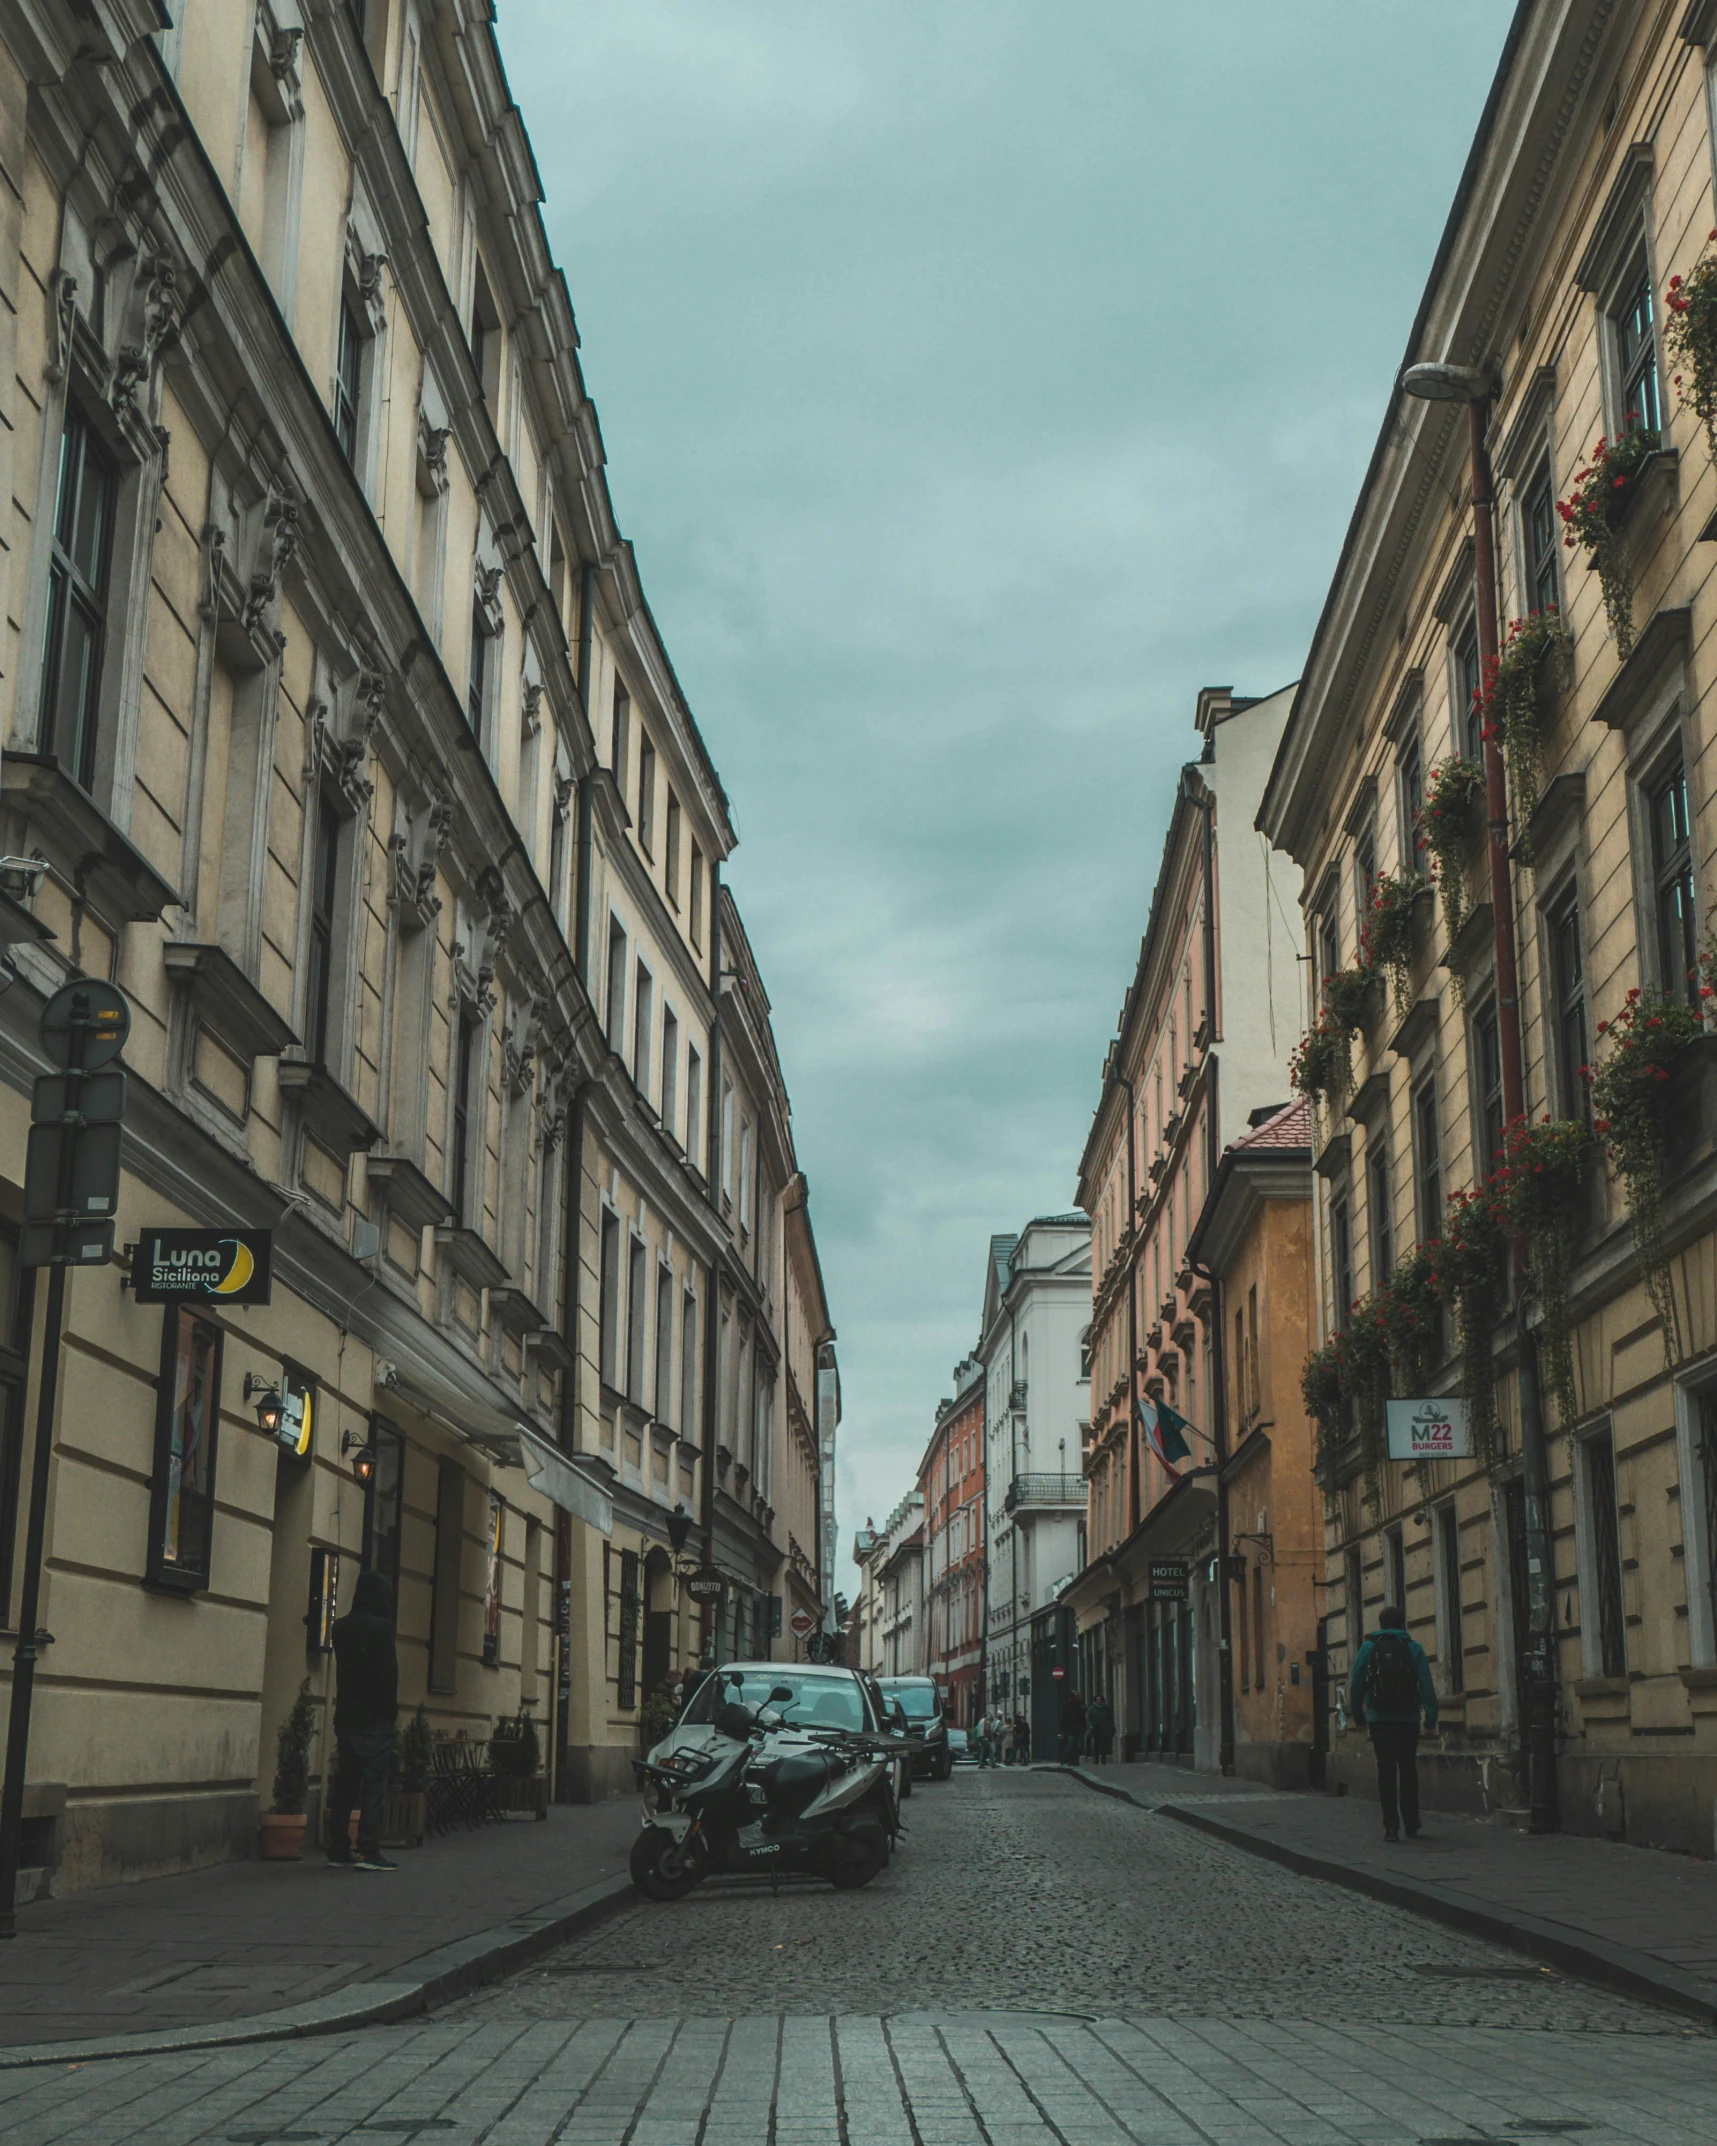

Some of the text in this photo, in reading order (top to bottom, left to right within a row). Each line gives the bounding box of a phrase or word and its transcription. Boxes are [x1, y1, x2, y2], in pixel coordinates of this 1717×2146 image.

[153, 1239, 221, 1266] Luna
[152, 1267, 220, 1282] Siciliana
[151, 1282, 197, 1290] RISTORANTE
[1411, 1424, 1452, 1441] M22
[1412, 1442, 1453, 1450] BURGERS
[1152, 1567, 1185, 1576] HOTEL
[690, 1581, 721, 1592] DONIZETTI
[1153, 1588, 1185, 1597] UNICUS
[750, 1844, 780, 1855] KYMCO
